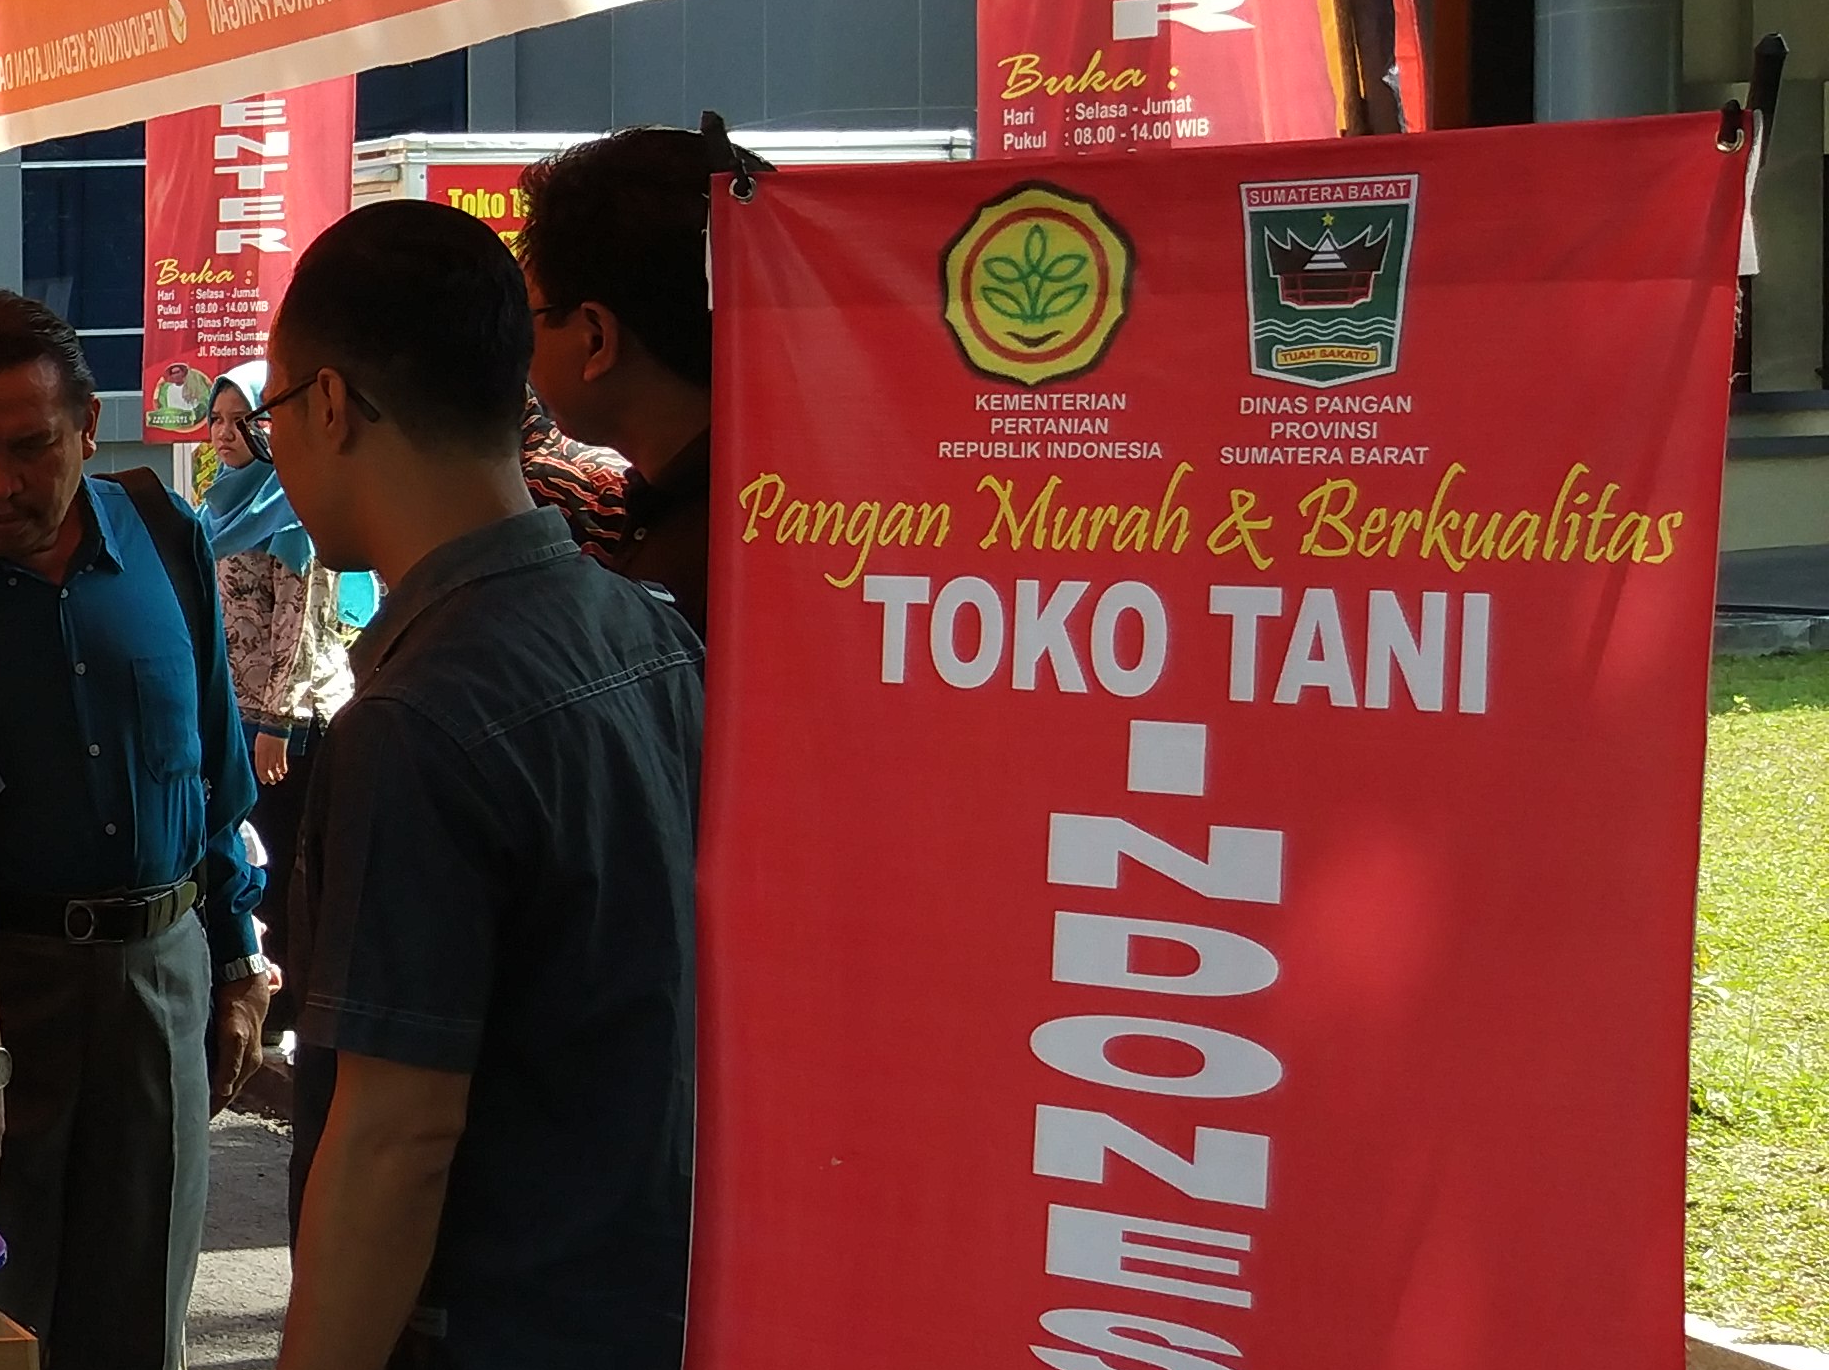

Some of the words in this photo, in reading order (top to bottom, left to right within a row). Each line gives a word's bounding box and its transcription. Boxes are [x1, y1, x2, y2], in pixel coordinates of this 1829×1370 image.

[997, 49, 1149, 101] Buka
[1002, 106, 1035, 127] Hari
[1074, 100, 1129, 122] Selasa
[1141, 95, 1192, 117] Jumat
[1002, 130, 1048, 152] Pukul
[1073, 125, 1118, 146] 08.00
[1130, 121, 1173, 142] 14.00
[1175, 118, 1210, 140] WIB
[214, 99, 292, 254] ENTER
[447, 188, 506, 219] Toko
[1249, 186, 1345, 205] SUMATERA
[1347, 182, 1407, 200] BARAT
[154, 258, 235, 285] Buka
[157, 289, 175, 301] Hari
[195, 288, 224, 300] Selasa
[231, 287, 260, 299] Jumat
[157, 304, 182, 315] Pukul
[249, 300, 269, 313] WIB
[157, 318, 189, 331] Tempat
[196, 317, 221, 329] Dinas
[222, 317, 257, 330] Pangan
[197, 331, 233, 343] Provinsi
[234, 330, 270, 342] Sumate
[974, 393, 1127, 412] KEMENTERIAN
[1239, 396, 1308, 415] DINAS
[1314, 395, 1413, 415] PANGAN
[989, 416, 1110, 436] PERTANIAN
[1270, 420, 1379, 441] PROVINSI
[938, 440, 1042, 460] REPUBLIK
[1046, 440, 1163, 461] INDONESIA
[1219, 445, 1344, 466] SUMATERA
[1349, 445, 1430, 466] BARAT
[738, 471, 951, 589] Pangan
[975, 461, 1194, 555] Murah
[1205, 488, 1273, 572] &
[1297, 461, 1684, 573] Berkualitas
[862, 574, 1168, 698] TOKO
[1208, 584, 1491, 715] TANI
